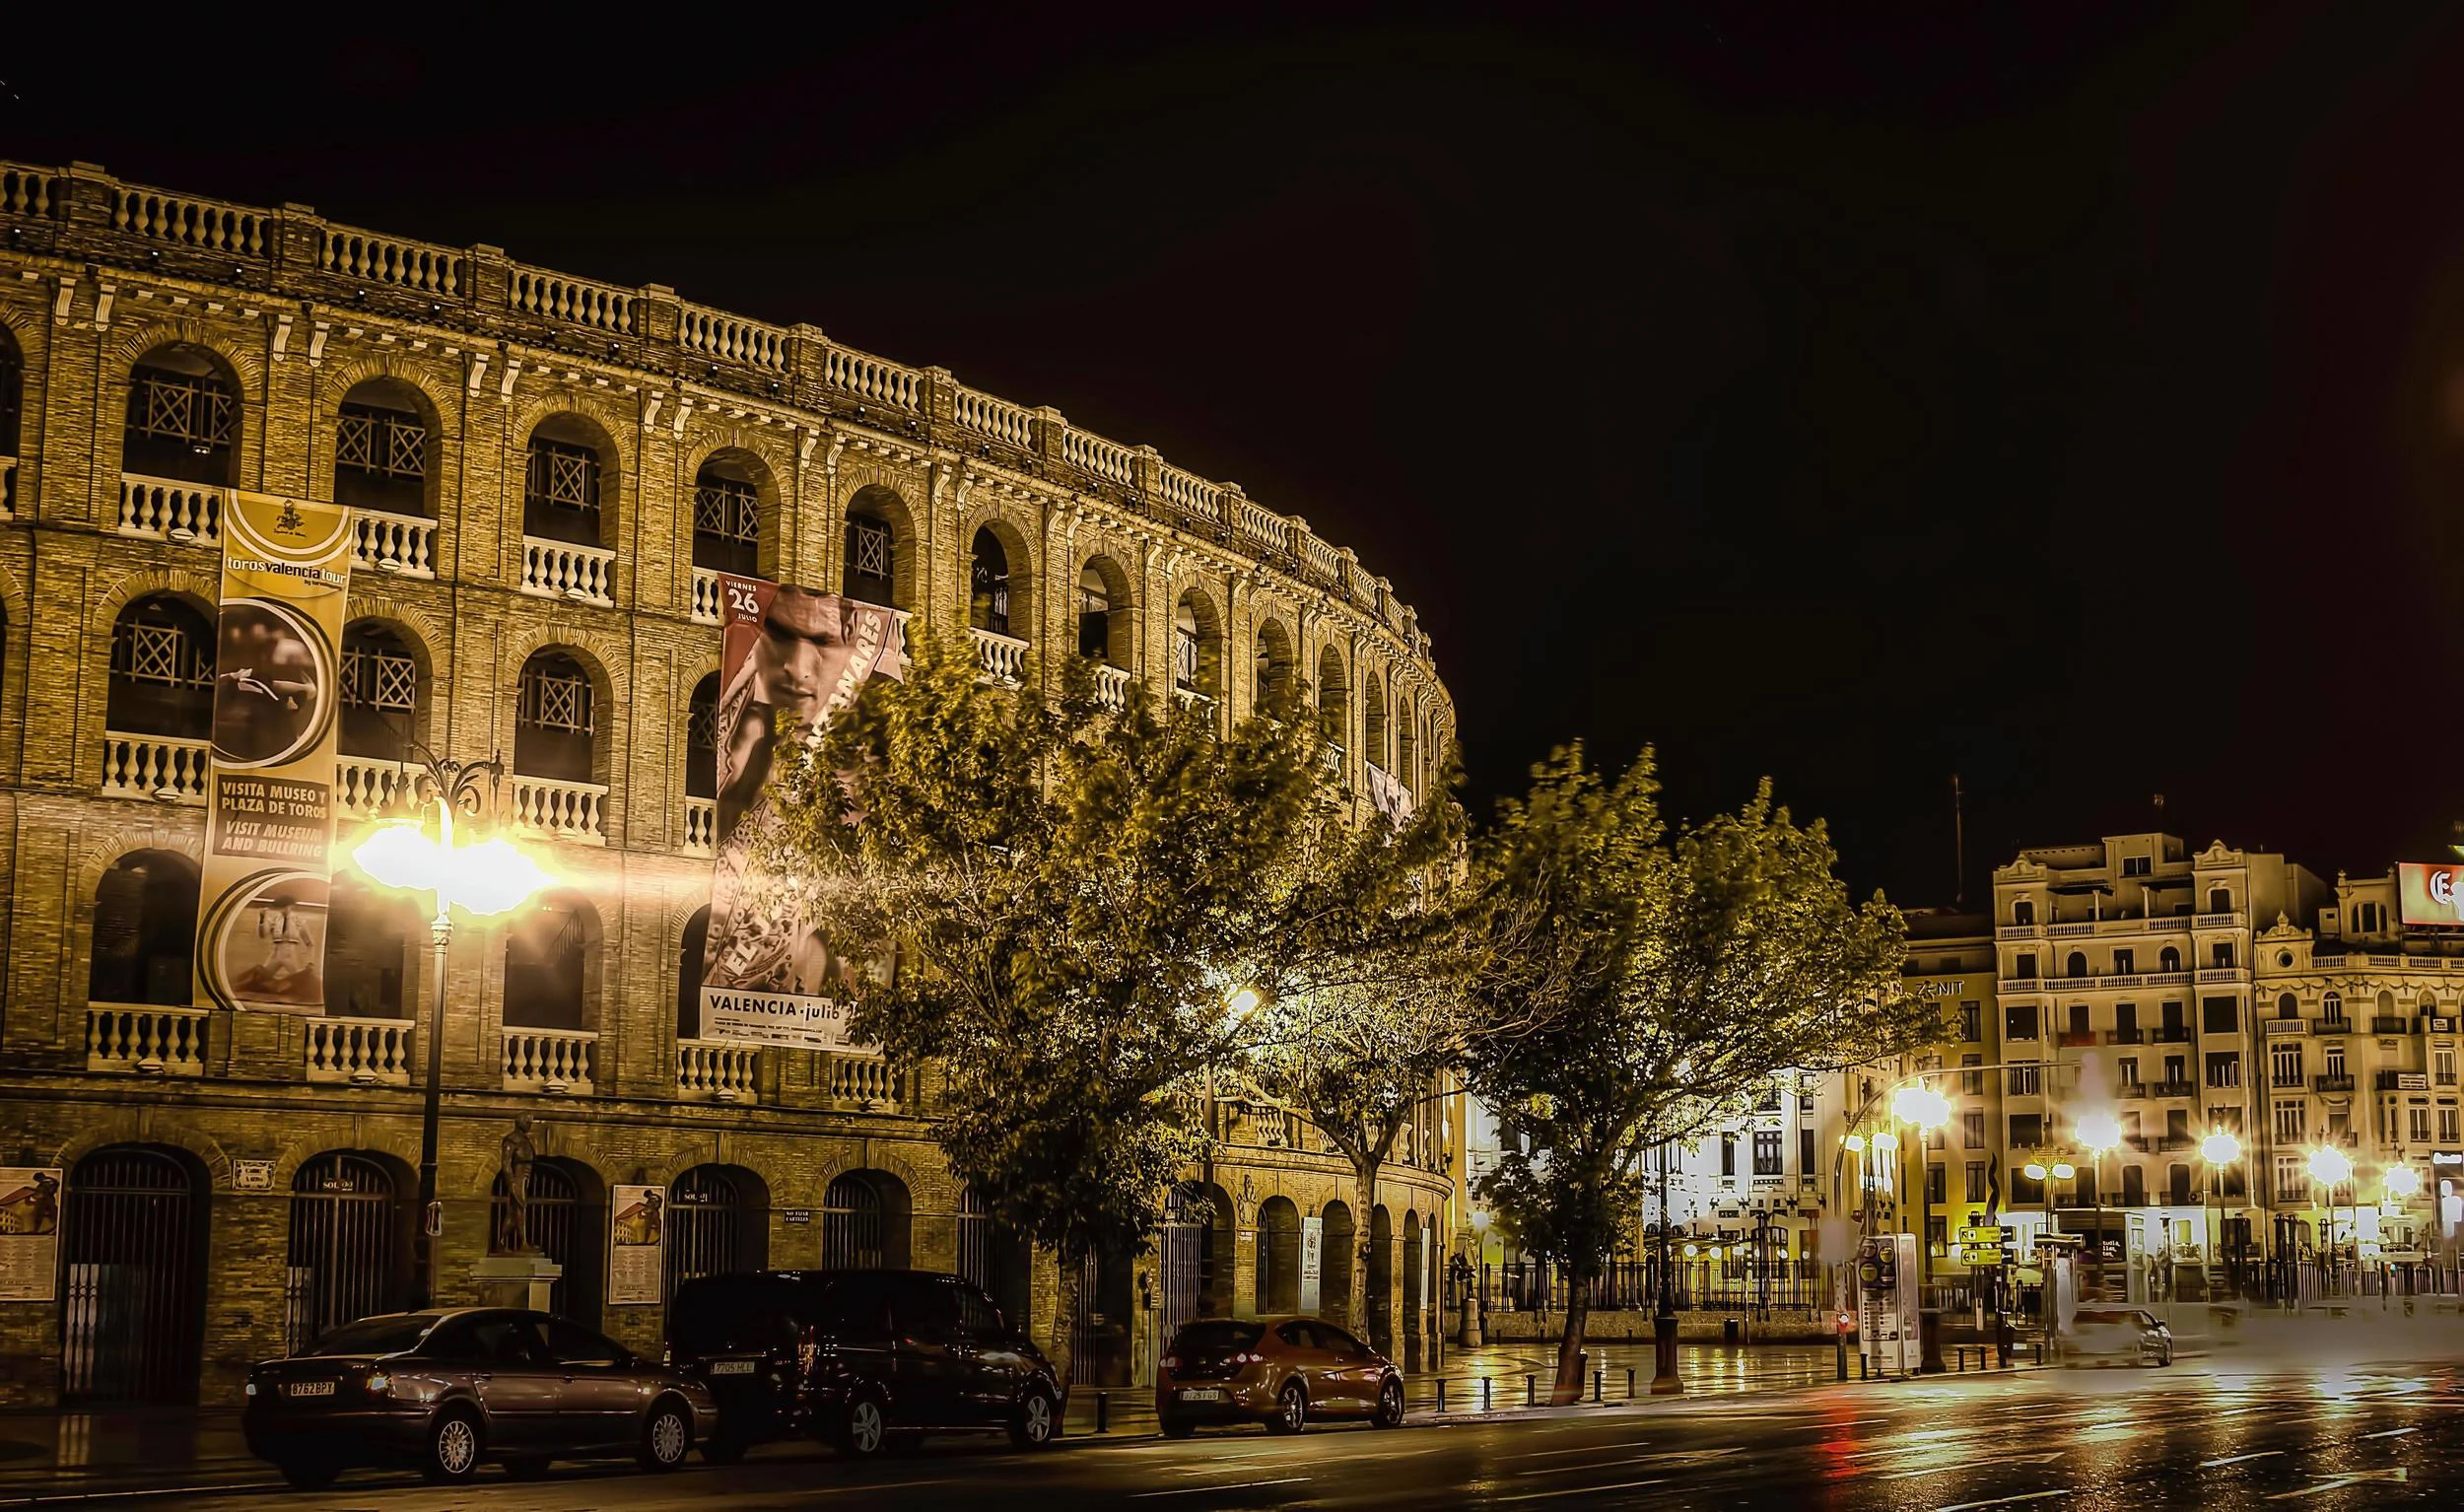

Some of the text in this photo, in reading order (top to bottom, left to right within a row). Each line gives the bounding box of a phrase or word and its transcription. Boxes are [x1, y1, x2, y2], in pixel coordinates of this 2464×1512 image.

[725, 581, 757, 591] VIERNES
[728, 588, 759, 614] 26
[737, 613, 757, 623] JULIO
[222, 782, 326, 804] VISITA MUSEO Y
[222, 797, 326, 819] PLAZA DE TOROS
[226, 821, 322, 842] VISIT MUSEUM
[222, 837, 321, 857] AND BULLRING
[710, 995, 796, 1016] VALENCIA
[805, 1003, 840, 1021] julio
